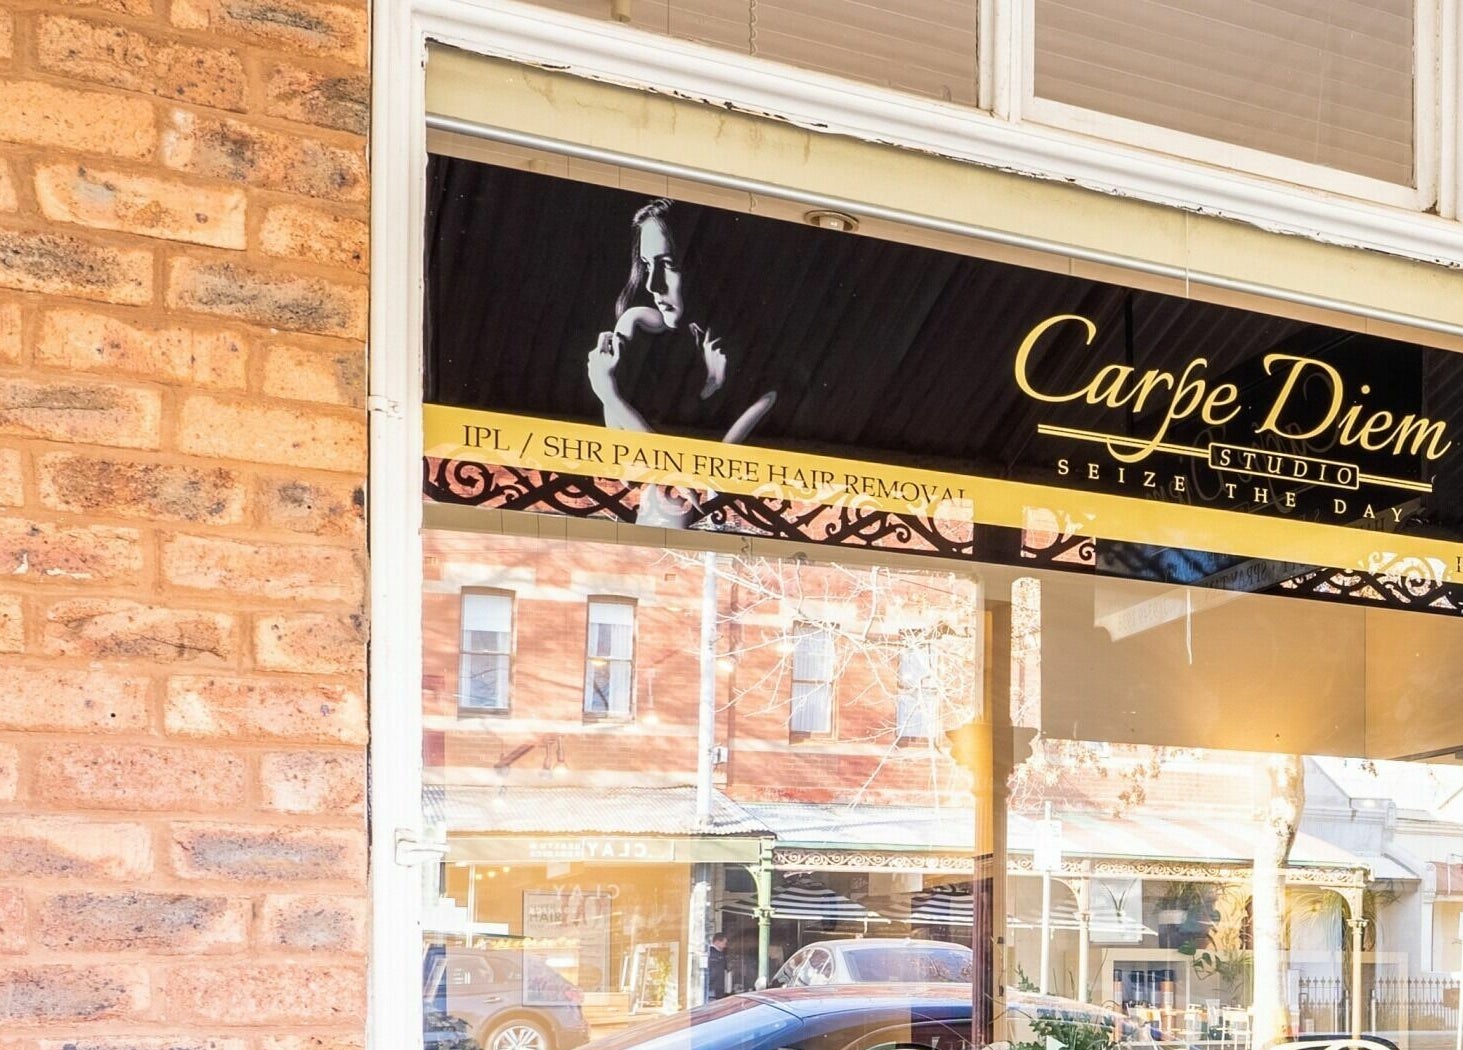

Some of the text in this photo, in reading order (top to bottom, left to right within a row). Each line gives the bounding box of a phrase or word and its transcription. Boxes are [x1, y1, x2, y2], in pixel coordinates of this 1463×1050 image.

[1014, 314, 1453, 463] Carpe Diem
[462, 424, 511, 451] IPL
[543, 435, 604, 463] SHR
[612, 443, 685, 473] PAIN
[693, 454, 760, 483] FREE
[768, 464, 836, 490] HAIR
[844, 473, 967, 503] REMOVAL
[1057, 458, 1404, 524] SEIZE THE DAY
[1218, 449, 1353, 485] STUDIO
